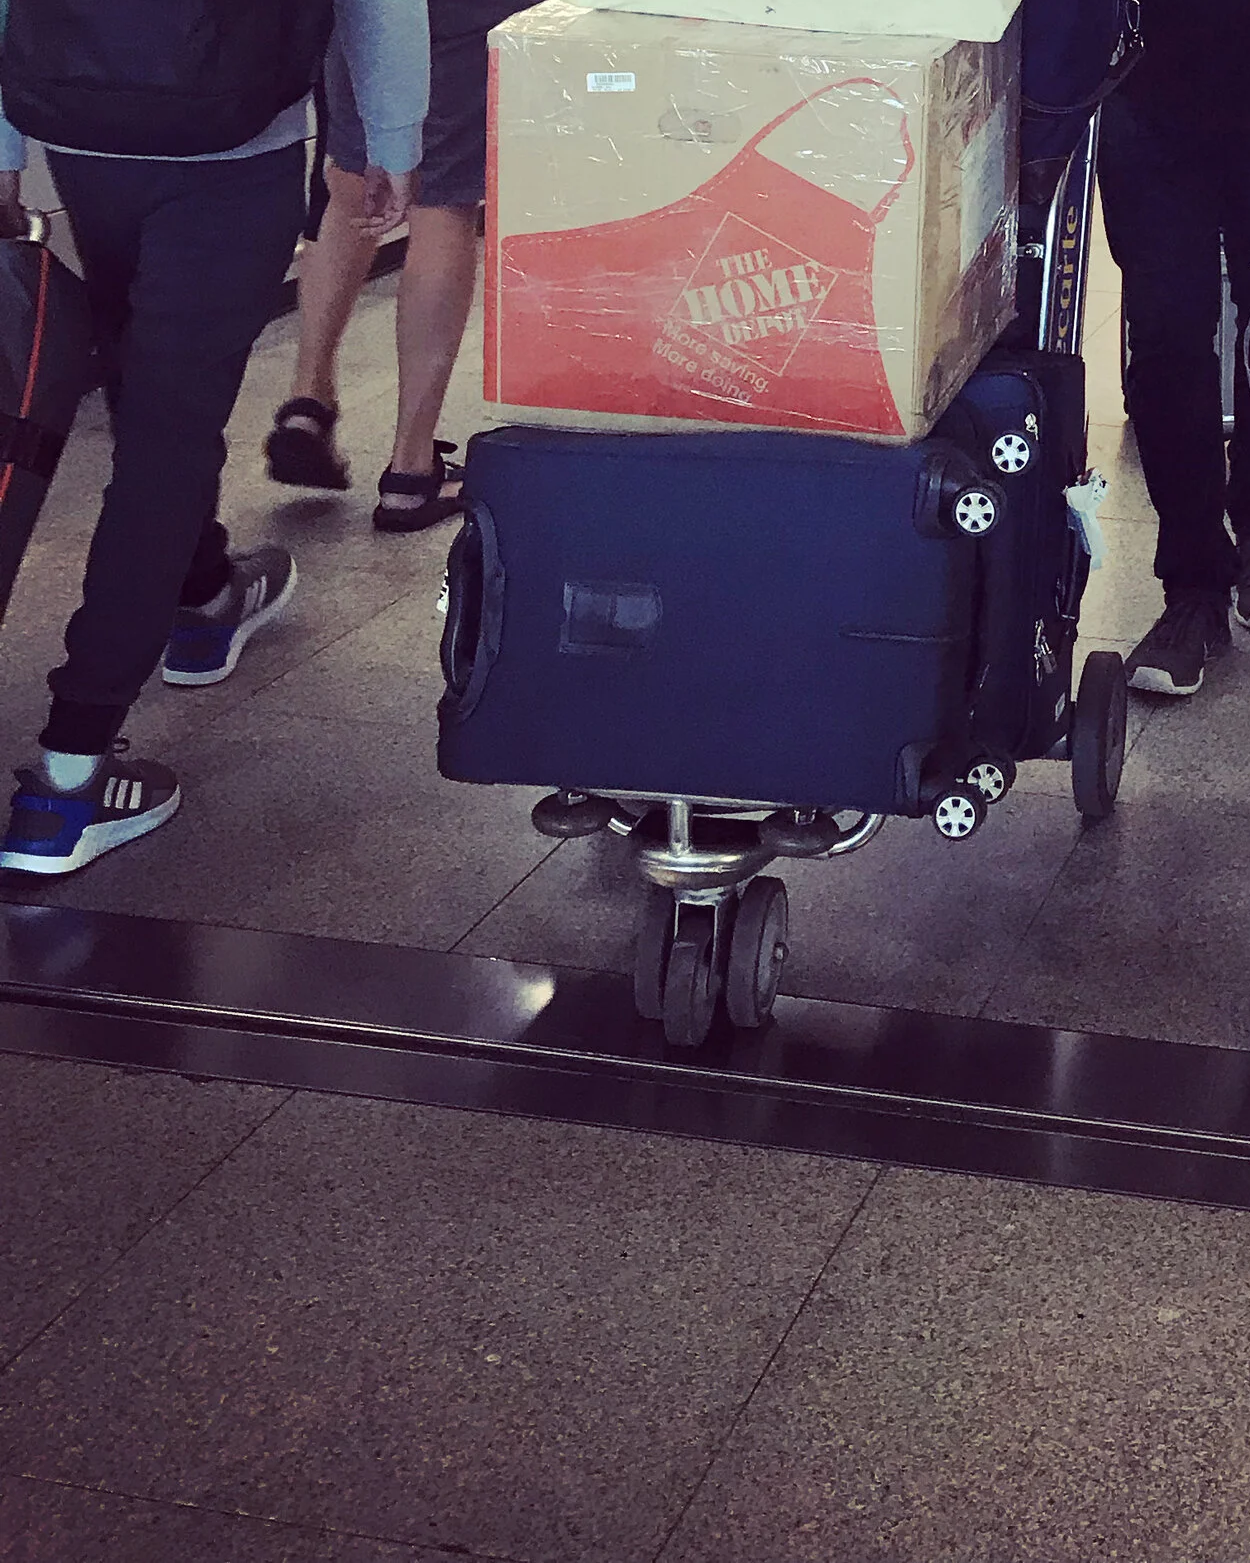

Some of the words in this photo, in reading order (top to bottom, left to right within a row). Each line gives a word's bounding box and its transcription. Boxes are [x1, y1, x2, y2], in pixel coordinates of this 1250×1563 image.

[716, 249, 770, 275] THE
[683, 263, 829, 327] HOME
[723, 309, 806, 347] DEPOT
[652, 337, 698, 373] More
[662, 318, 707, 355] More
[710, 350, 770, 393] saving.
